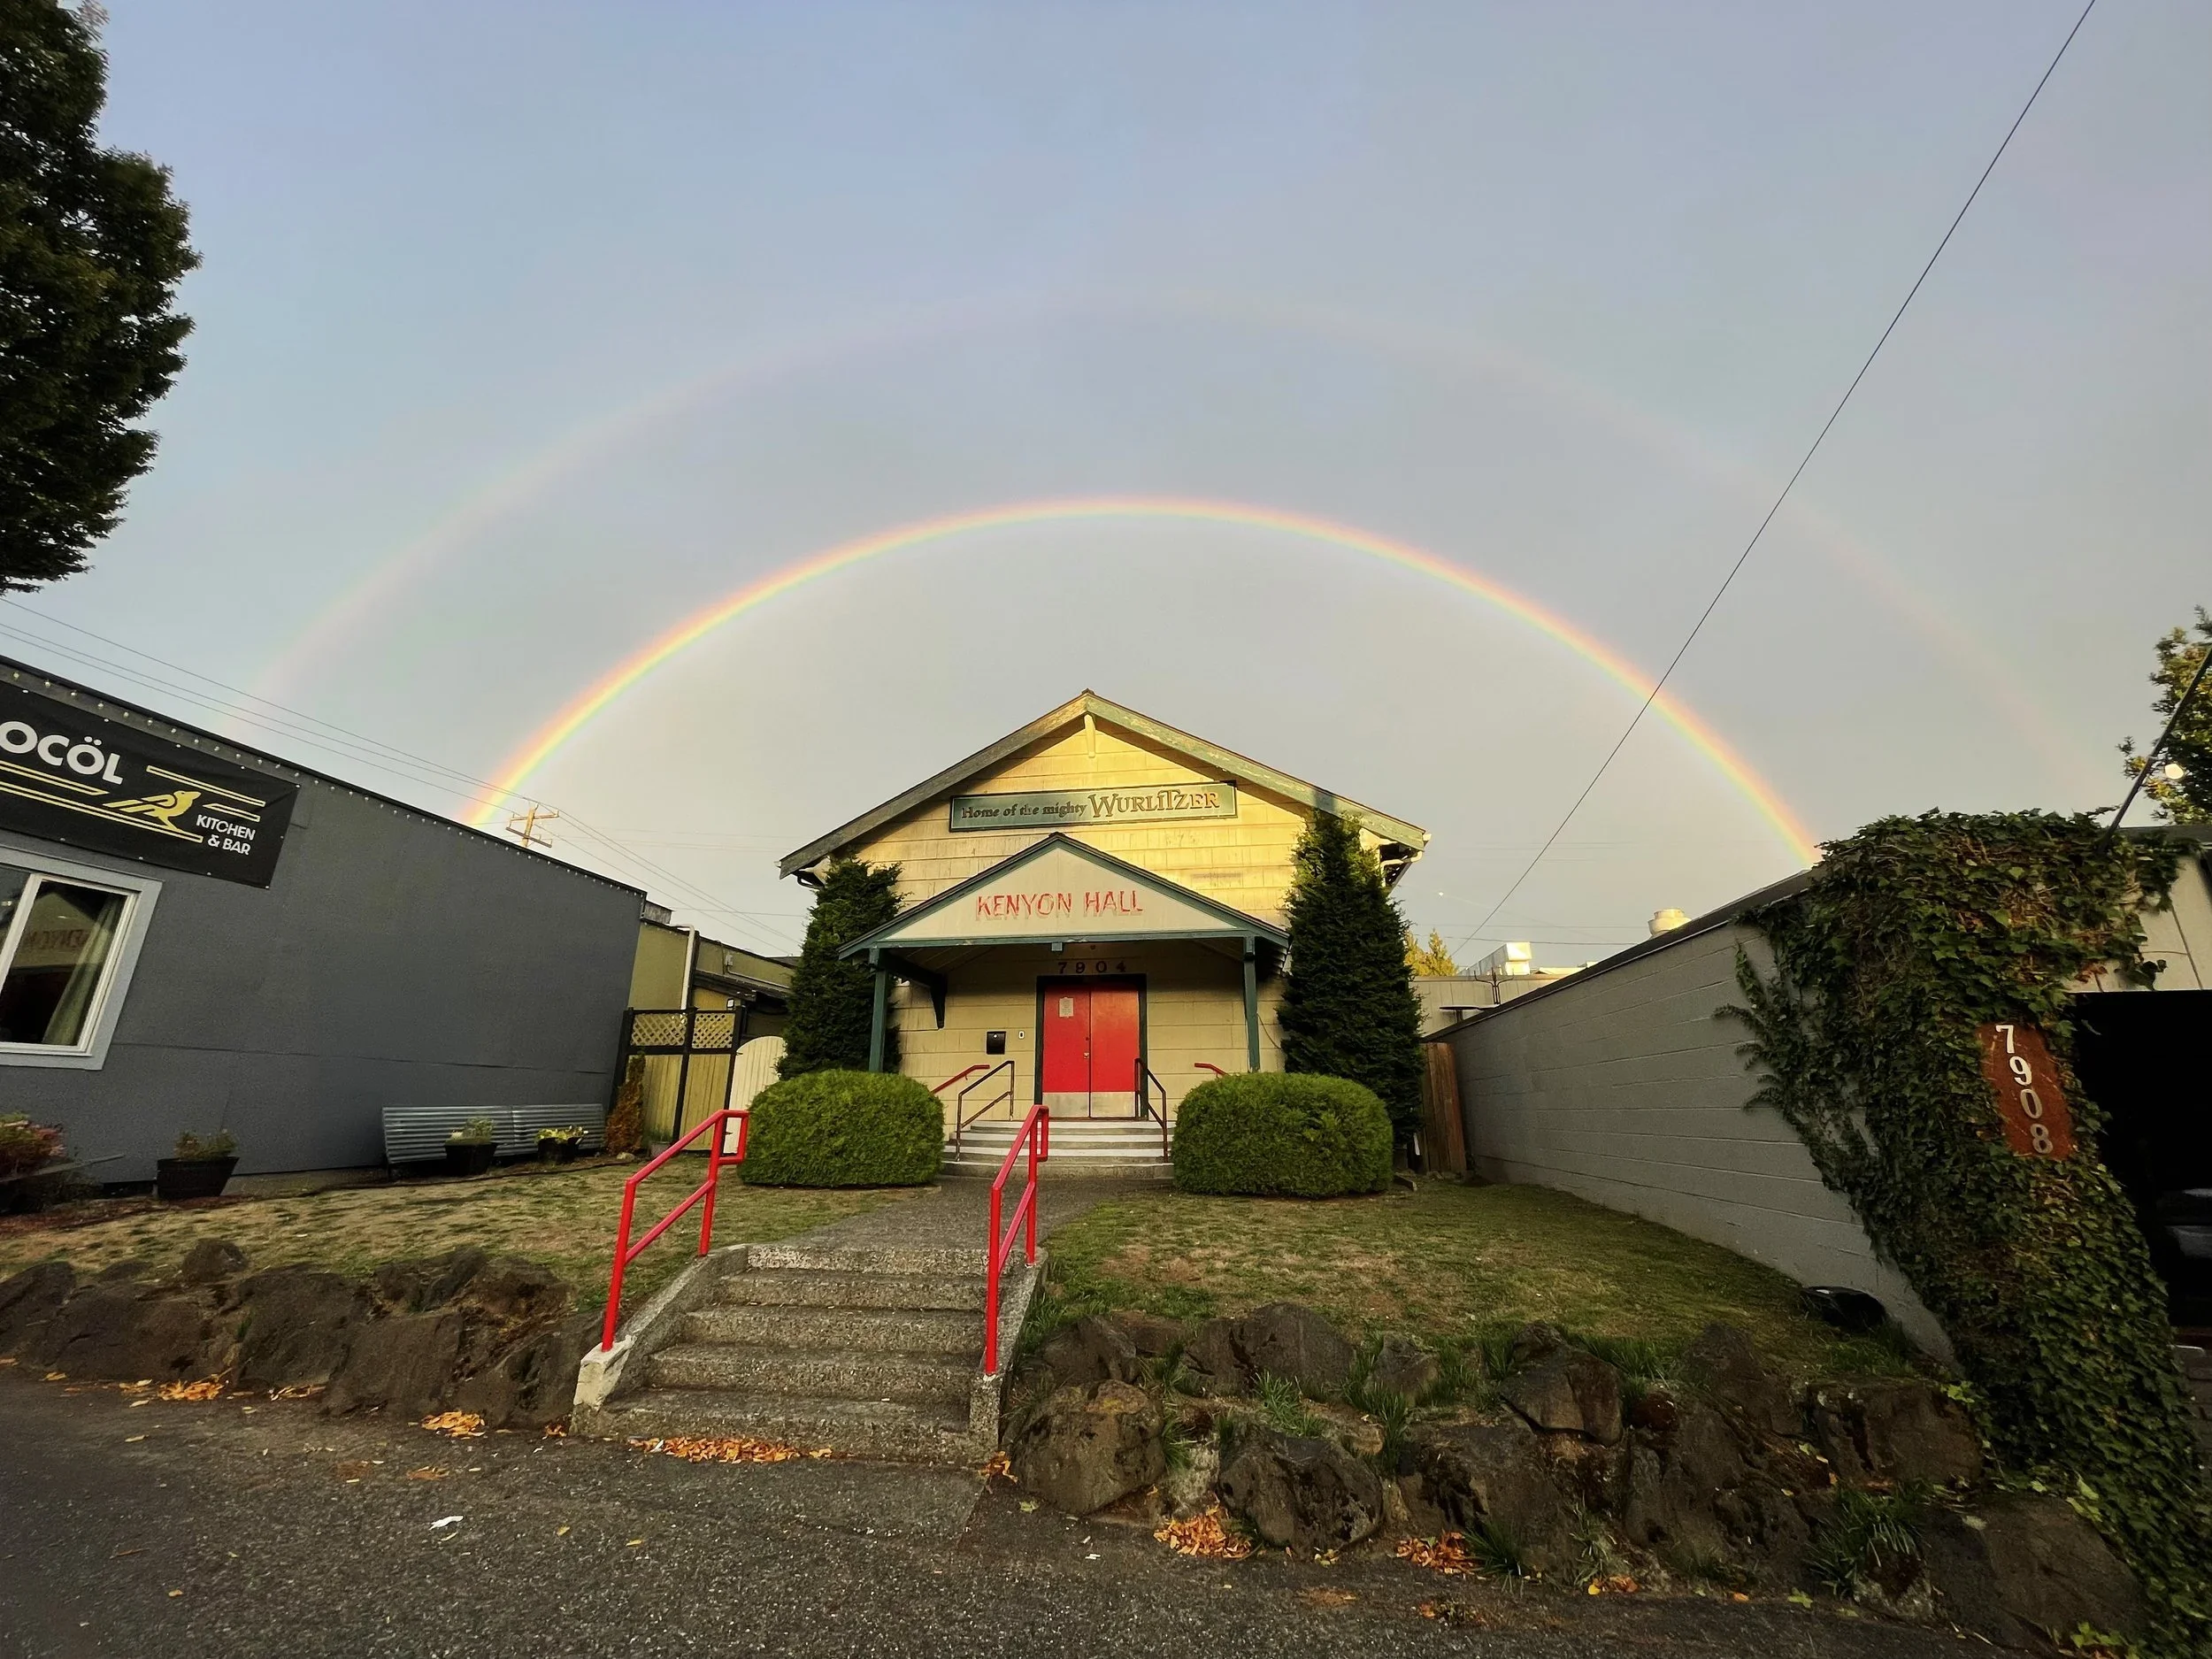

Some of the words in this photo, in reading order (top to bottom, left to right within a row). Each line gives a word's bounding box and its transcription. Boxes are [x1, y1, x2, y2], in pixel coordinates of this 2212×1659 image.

[0, 721, 123, 785] OCÖL
[962, 807, 1000, 818] Home
[1003, 803, 1018, 816] of
[1020, 803, 1039, 815] the
[1042, 802, 1087, 818] mighty
[196, 814, 256, 841] KITCHEN
[207, 834, 220, 848] &
[222, 838, 251, 856] BAR
[976, 893, 1071, 918] KENYON
[1084, 890, 1144, 915] HALL
[1058, 960, 1126, 974] 7904
[1995, 1025, 2054, 1154] 7908
